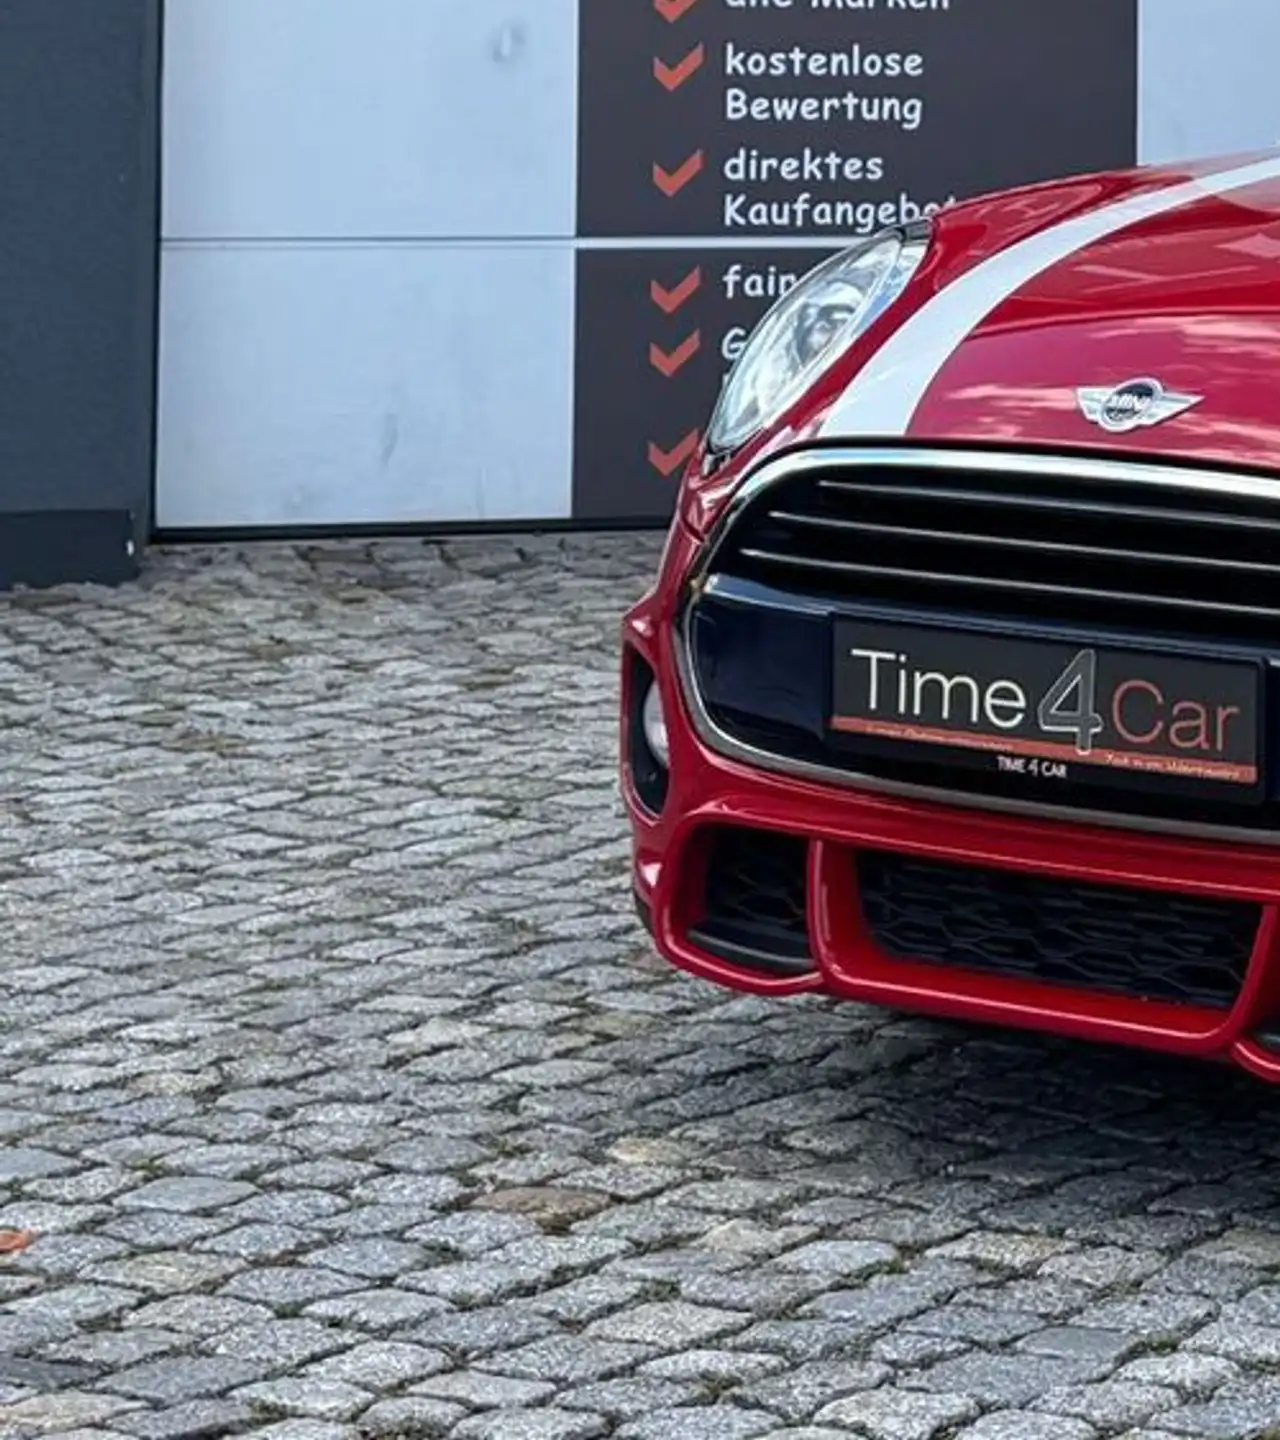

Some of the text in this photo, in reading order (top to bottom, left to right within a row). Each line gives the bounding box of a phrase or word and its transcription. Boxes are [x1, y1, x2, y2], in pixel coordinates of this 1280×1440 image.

[725, 42, 924, 77] kostenlose
[726, 87, 923, 131] Bewertung
[723, 147, 884, 181] direktes
[724, 192, 955, 234] Kaufangebo
[849, 648, 1240, 756] Time 4 Car
